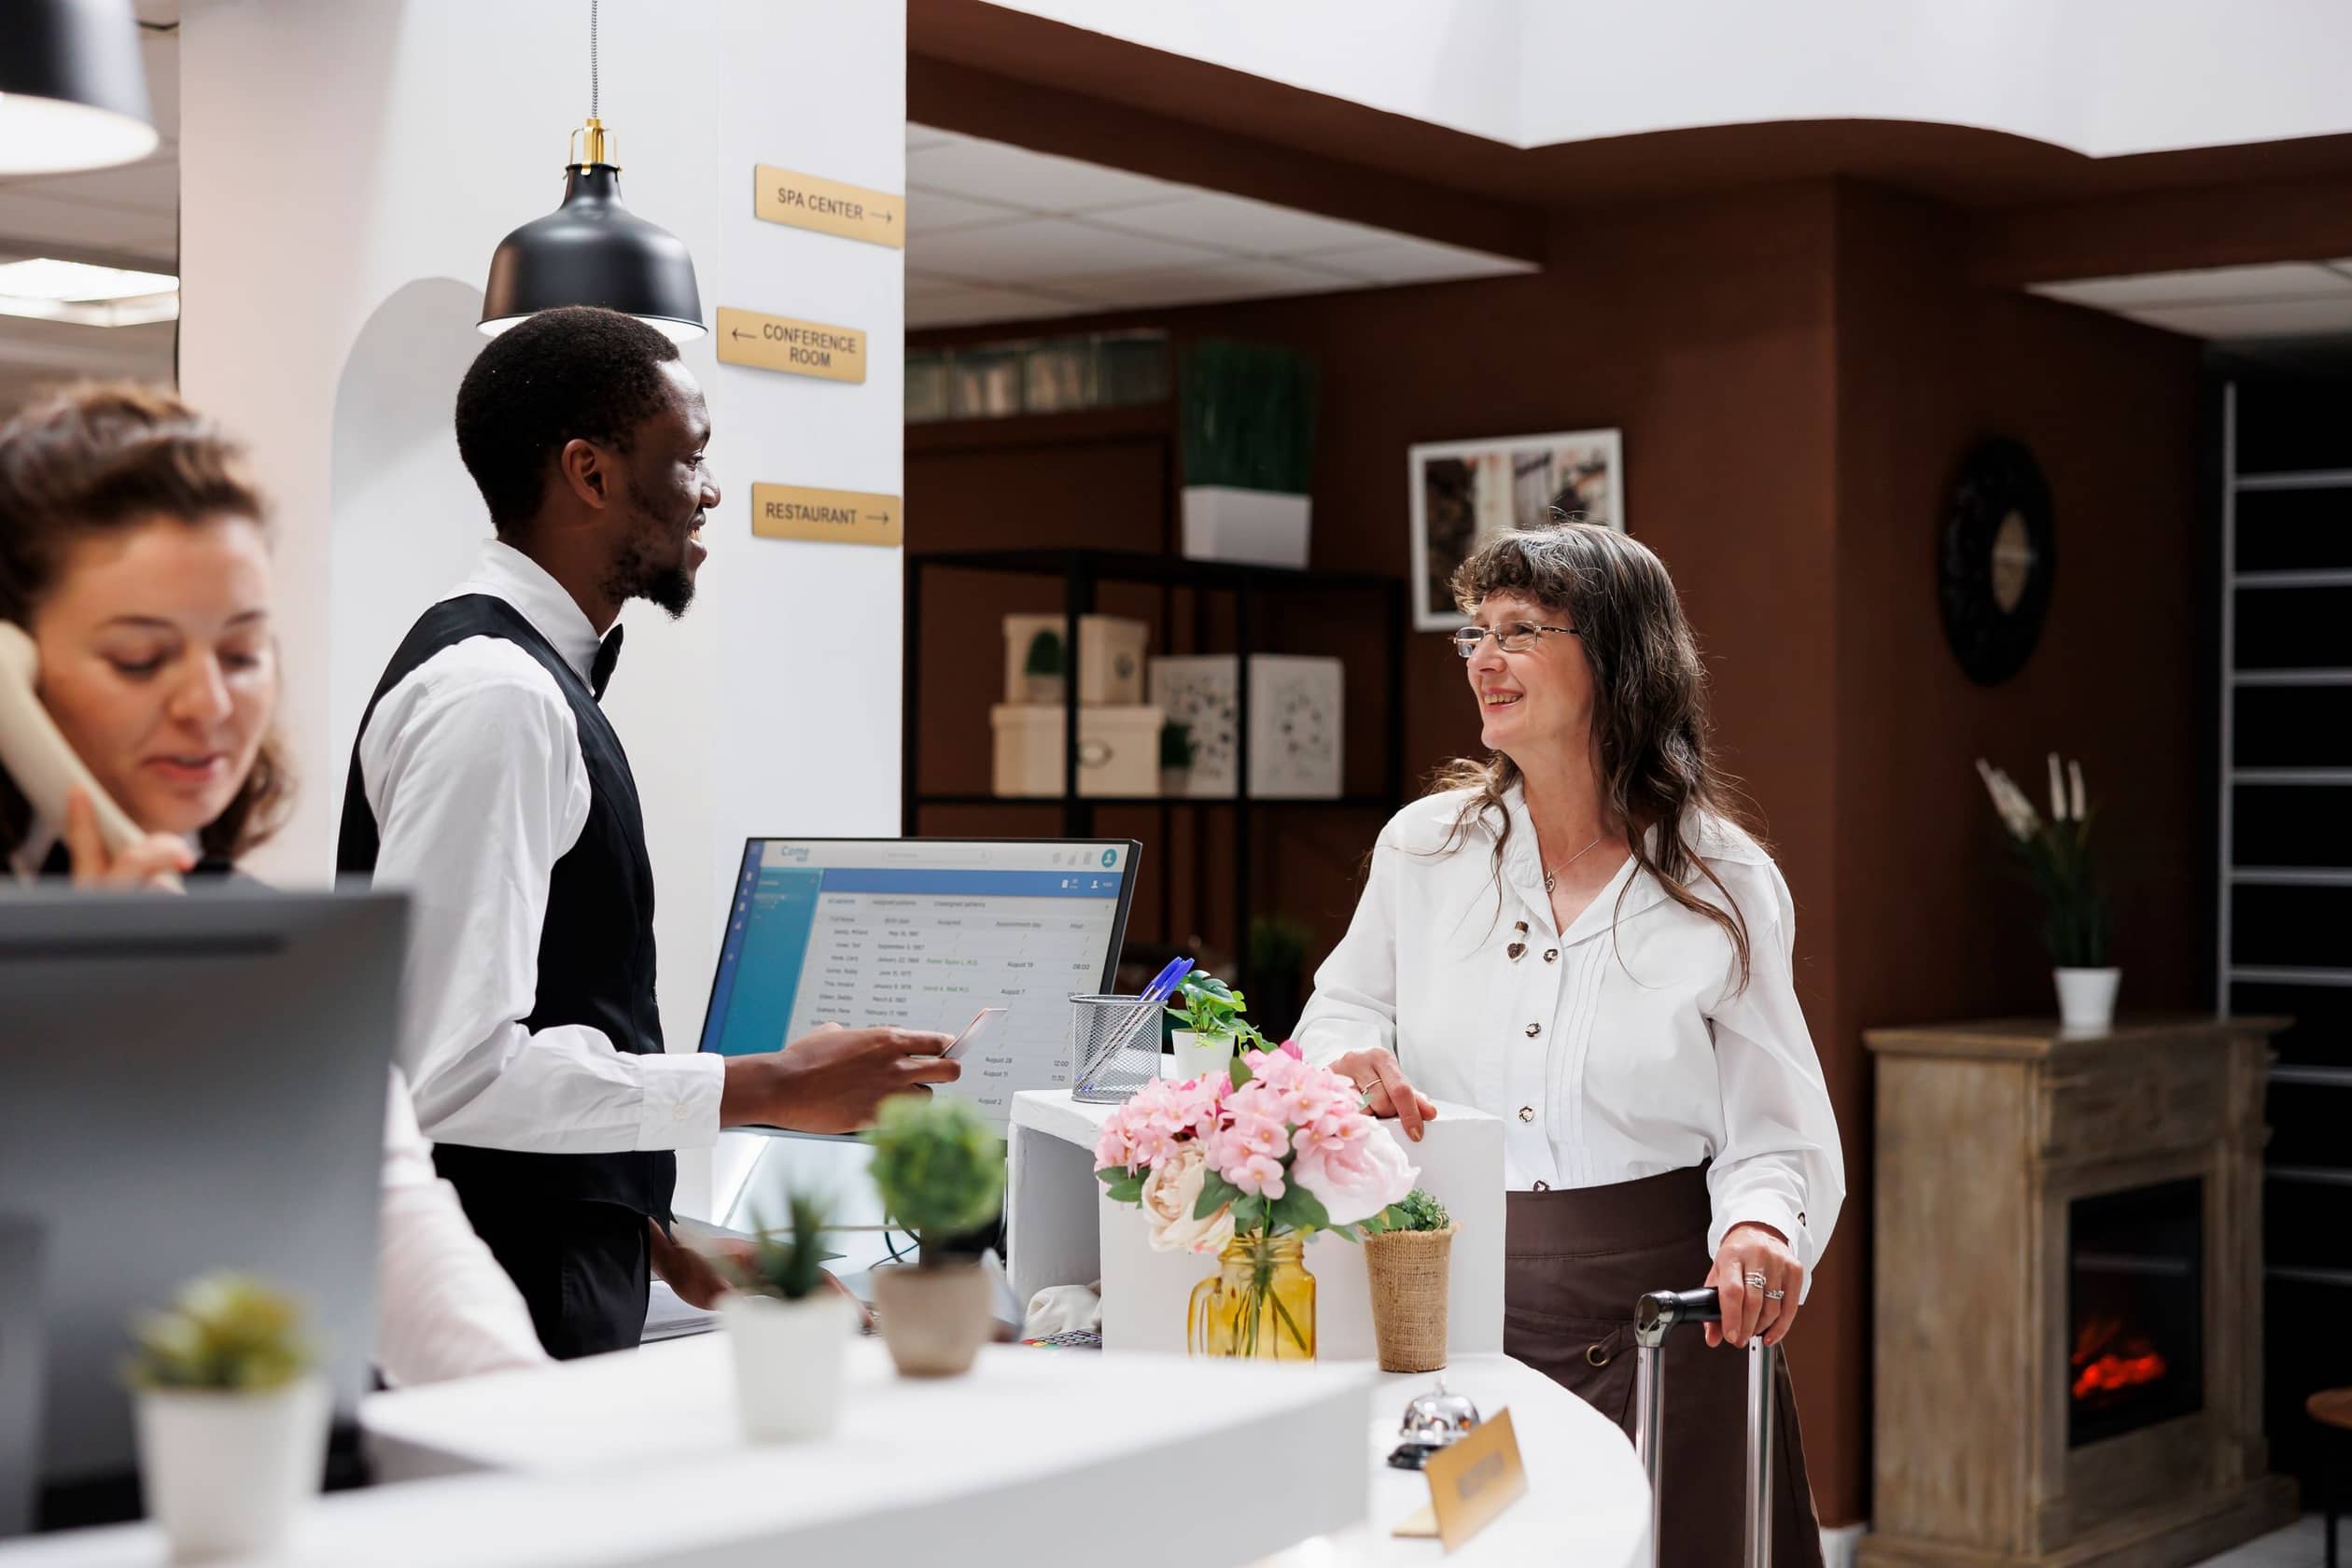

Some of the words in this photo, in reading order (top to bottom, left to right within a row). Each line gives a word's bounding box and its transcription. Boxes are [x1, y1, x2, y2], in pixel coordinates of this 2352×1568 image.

[777, 188, 805, 207] SPA
[808, 194, 863, 219] CENTER
[763, 323, 856, 354] CONFERENCE
[790, 346, 831, 367] ROOM
[765, 501, 857, 525] RESTAURANT
